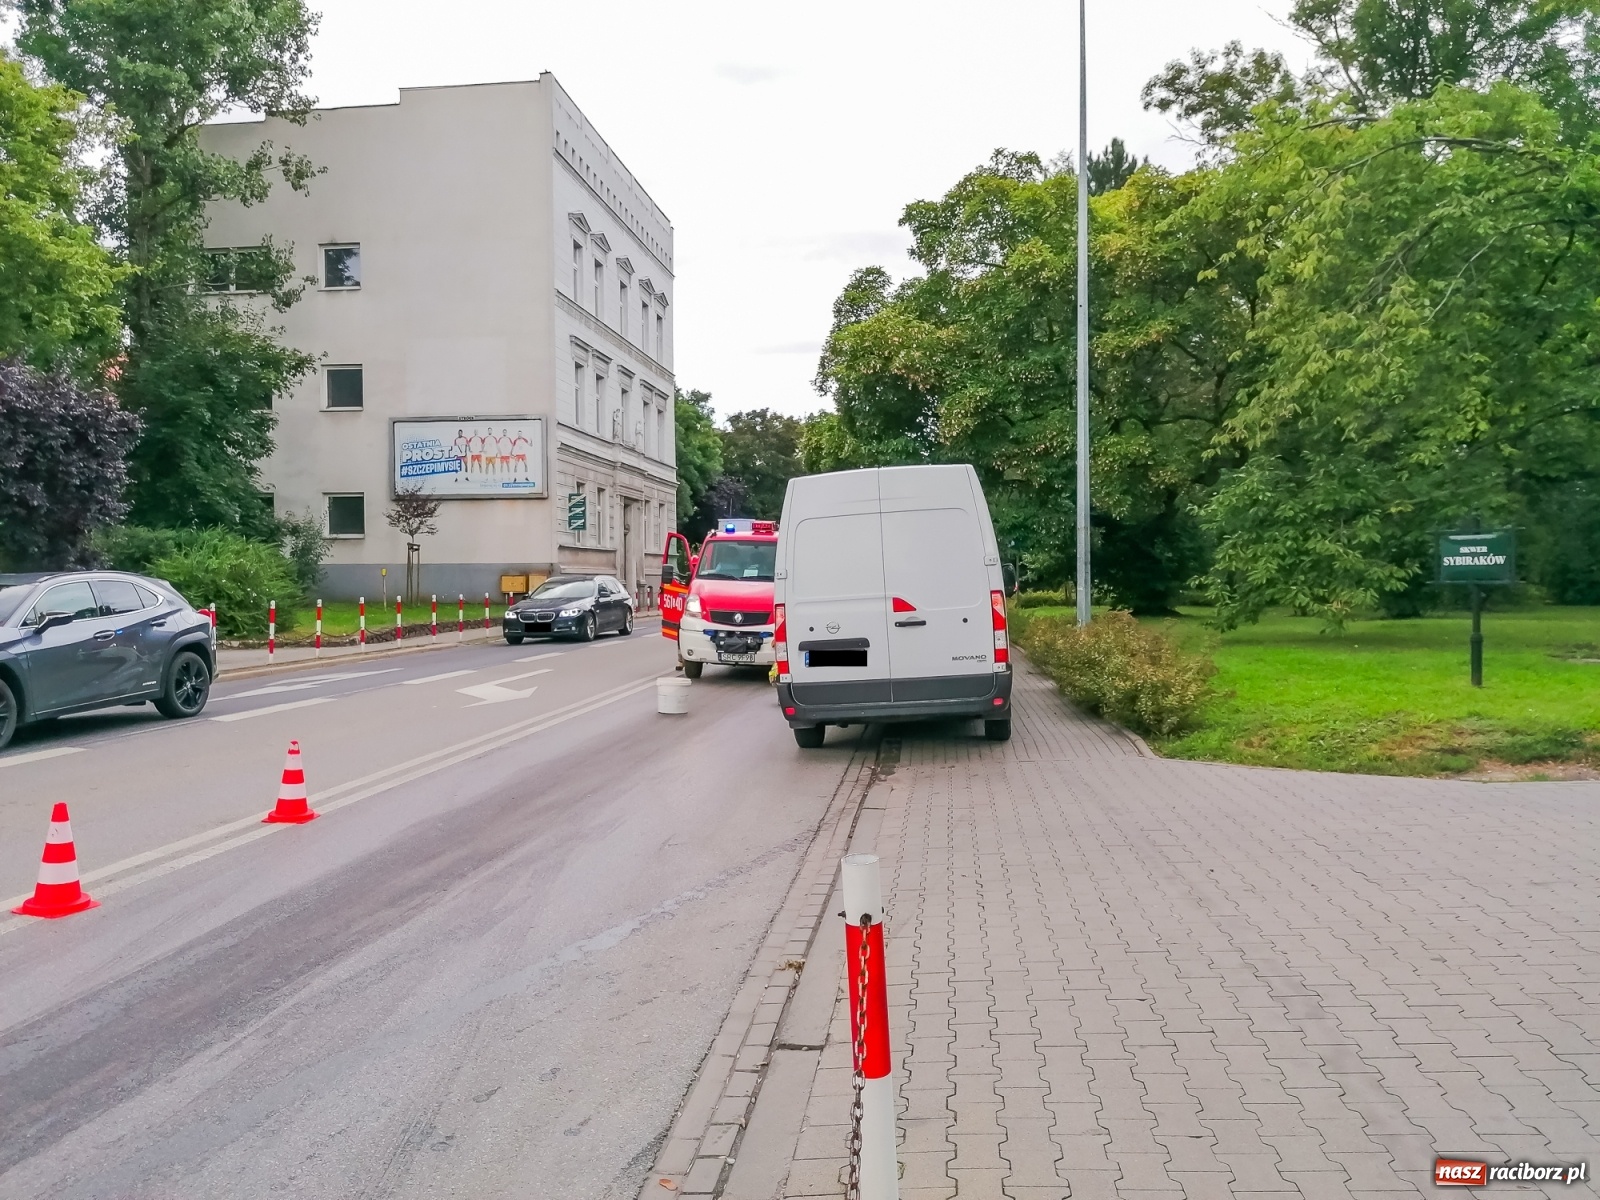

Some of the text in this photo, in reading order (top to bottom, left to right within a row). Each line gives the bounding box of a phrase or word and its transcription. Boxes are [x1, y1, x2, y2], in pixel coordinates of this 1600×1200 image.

[402, 439, 441, 450] OSTATNIA
[401, 460, 461, 477] #SZCZEPIMYSIĘ
[1443, 553, 1506, 566] SYBIRAKÓW
